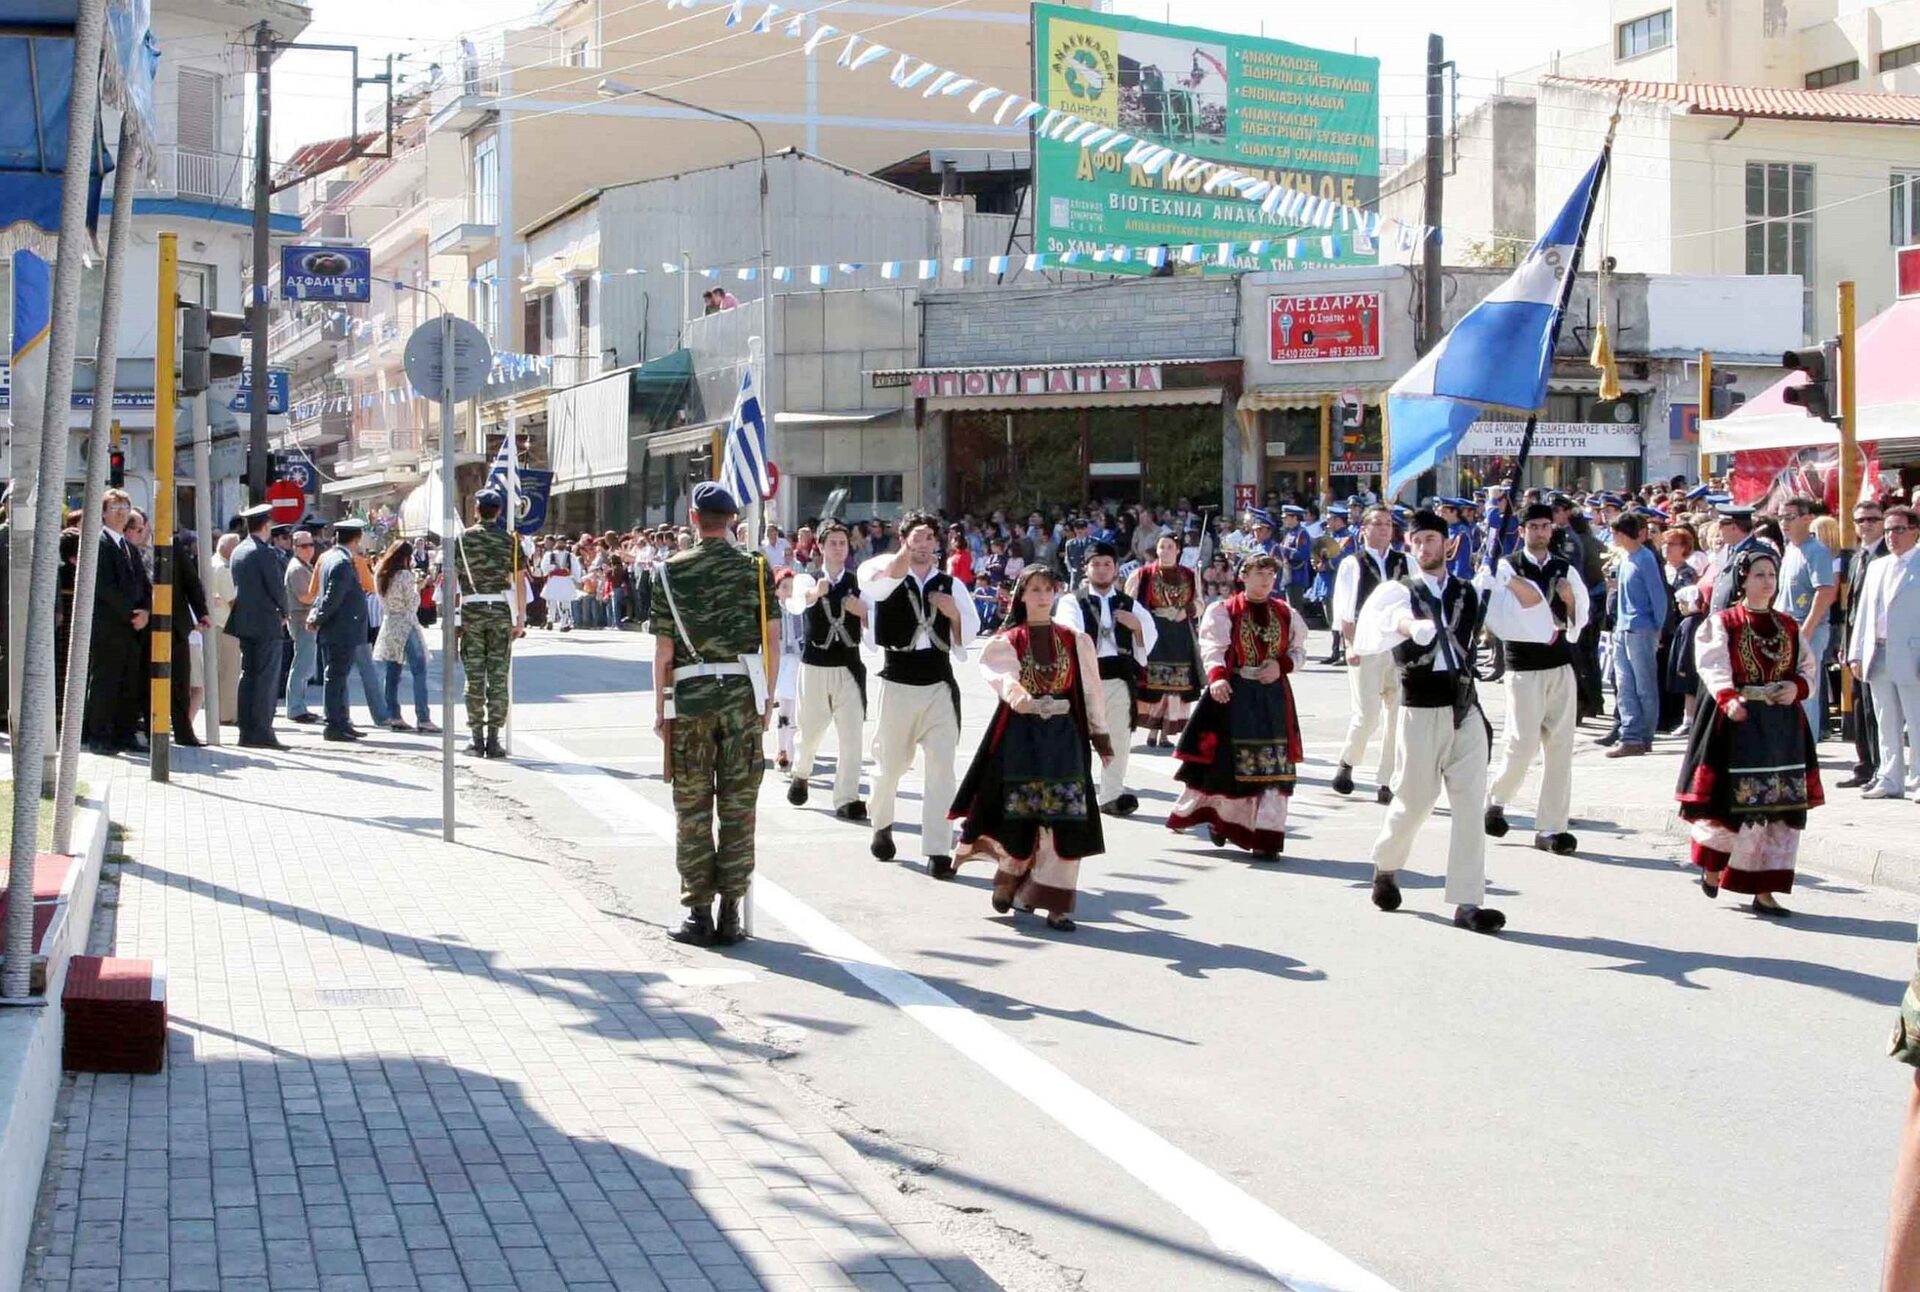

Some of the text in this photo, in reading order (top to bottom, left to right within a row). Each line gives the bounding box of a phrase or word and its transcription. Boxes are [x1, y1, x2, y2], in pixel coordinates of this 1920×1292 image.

[1109, 193, 1203, 219] ΒΙΟΤΕΧΝΙΑ
[1272, 295, 1378, 313] ΚΛΕΙΔΑΡΑΣ
[911, 365, 1160, 398] ΜΠΟΥΓΑΤΣΑ
[1506, 436, 1586, 448] ΑΛΗΛΕΓΓΥΗ
